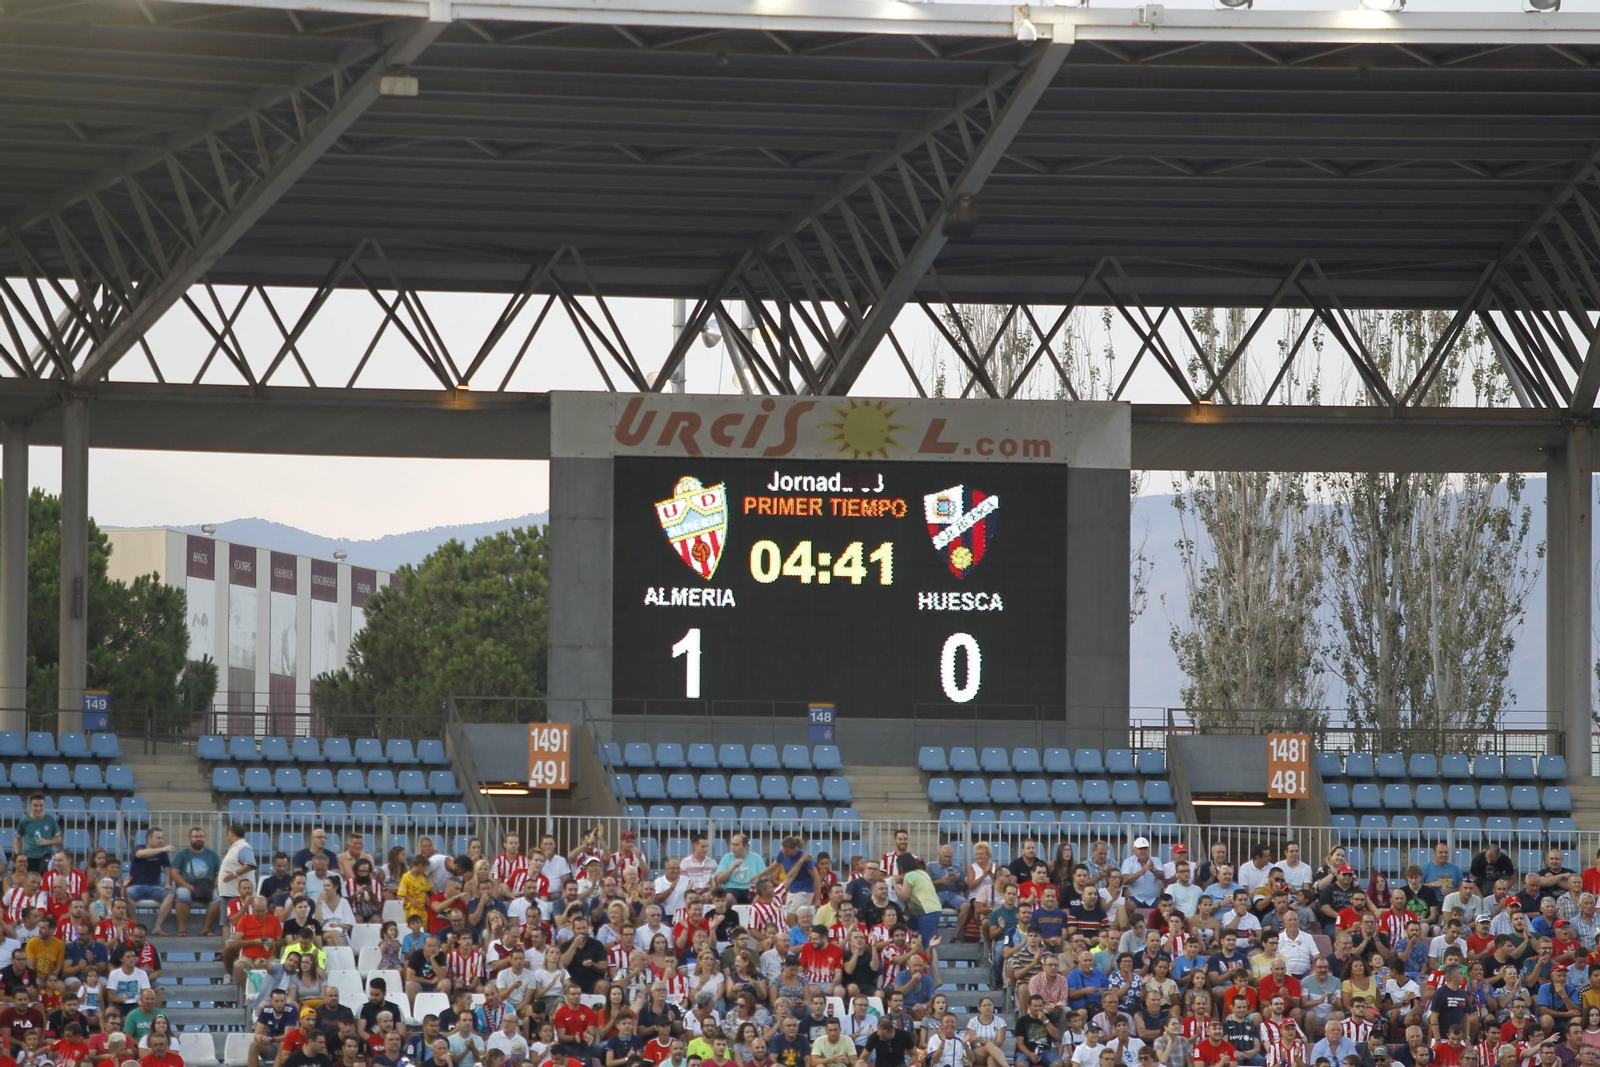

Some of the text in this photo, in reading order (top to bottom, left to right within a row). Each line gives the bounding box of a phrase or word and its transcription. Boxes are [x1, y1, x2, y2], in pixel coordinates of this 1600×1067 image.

[743, 496, 908, 519] PRIMER TIEMPO
[750, 539, 895, 586] 04:41
[644, 586, 736, 607] ALMERIA
[918, 591, 1003, 611] HUESCA
[672, 628, 701, 699] 1
[940, 632, 982, 703] 0
[85, 699, 107, 710] 149
[810, 712, 832, 723] 148
[531, 727, 561, 753] 149
[1270, 738, 1300, 763] 148
[531, 760, 558, 785] 49
[1271, 770, 1297, 795] 48
